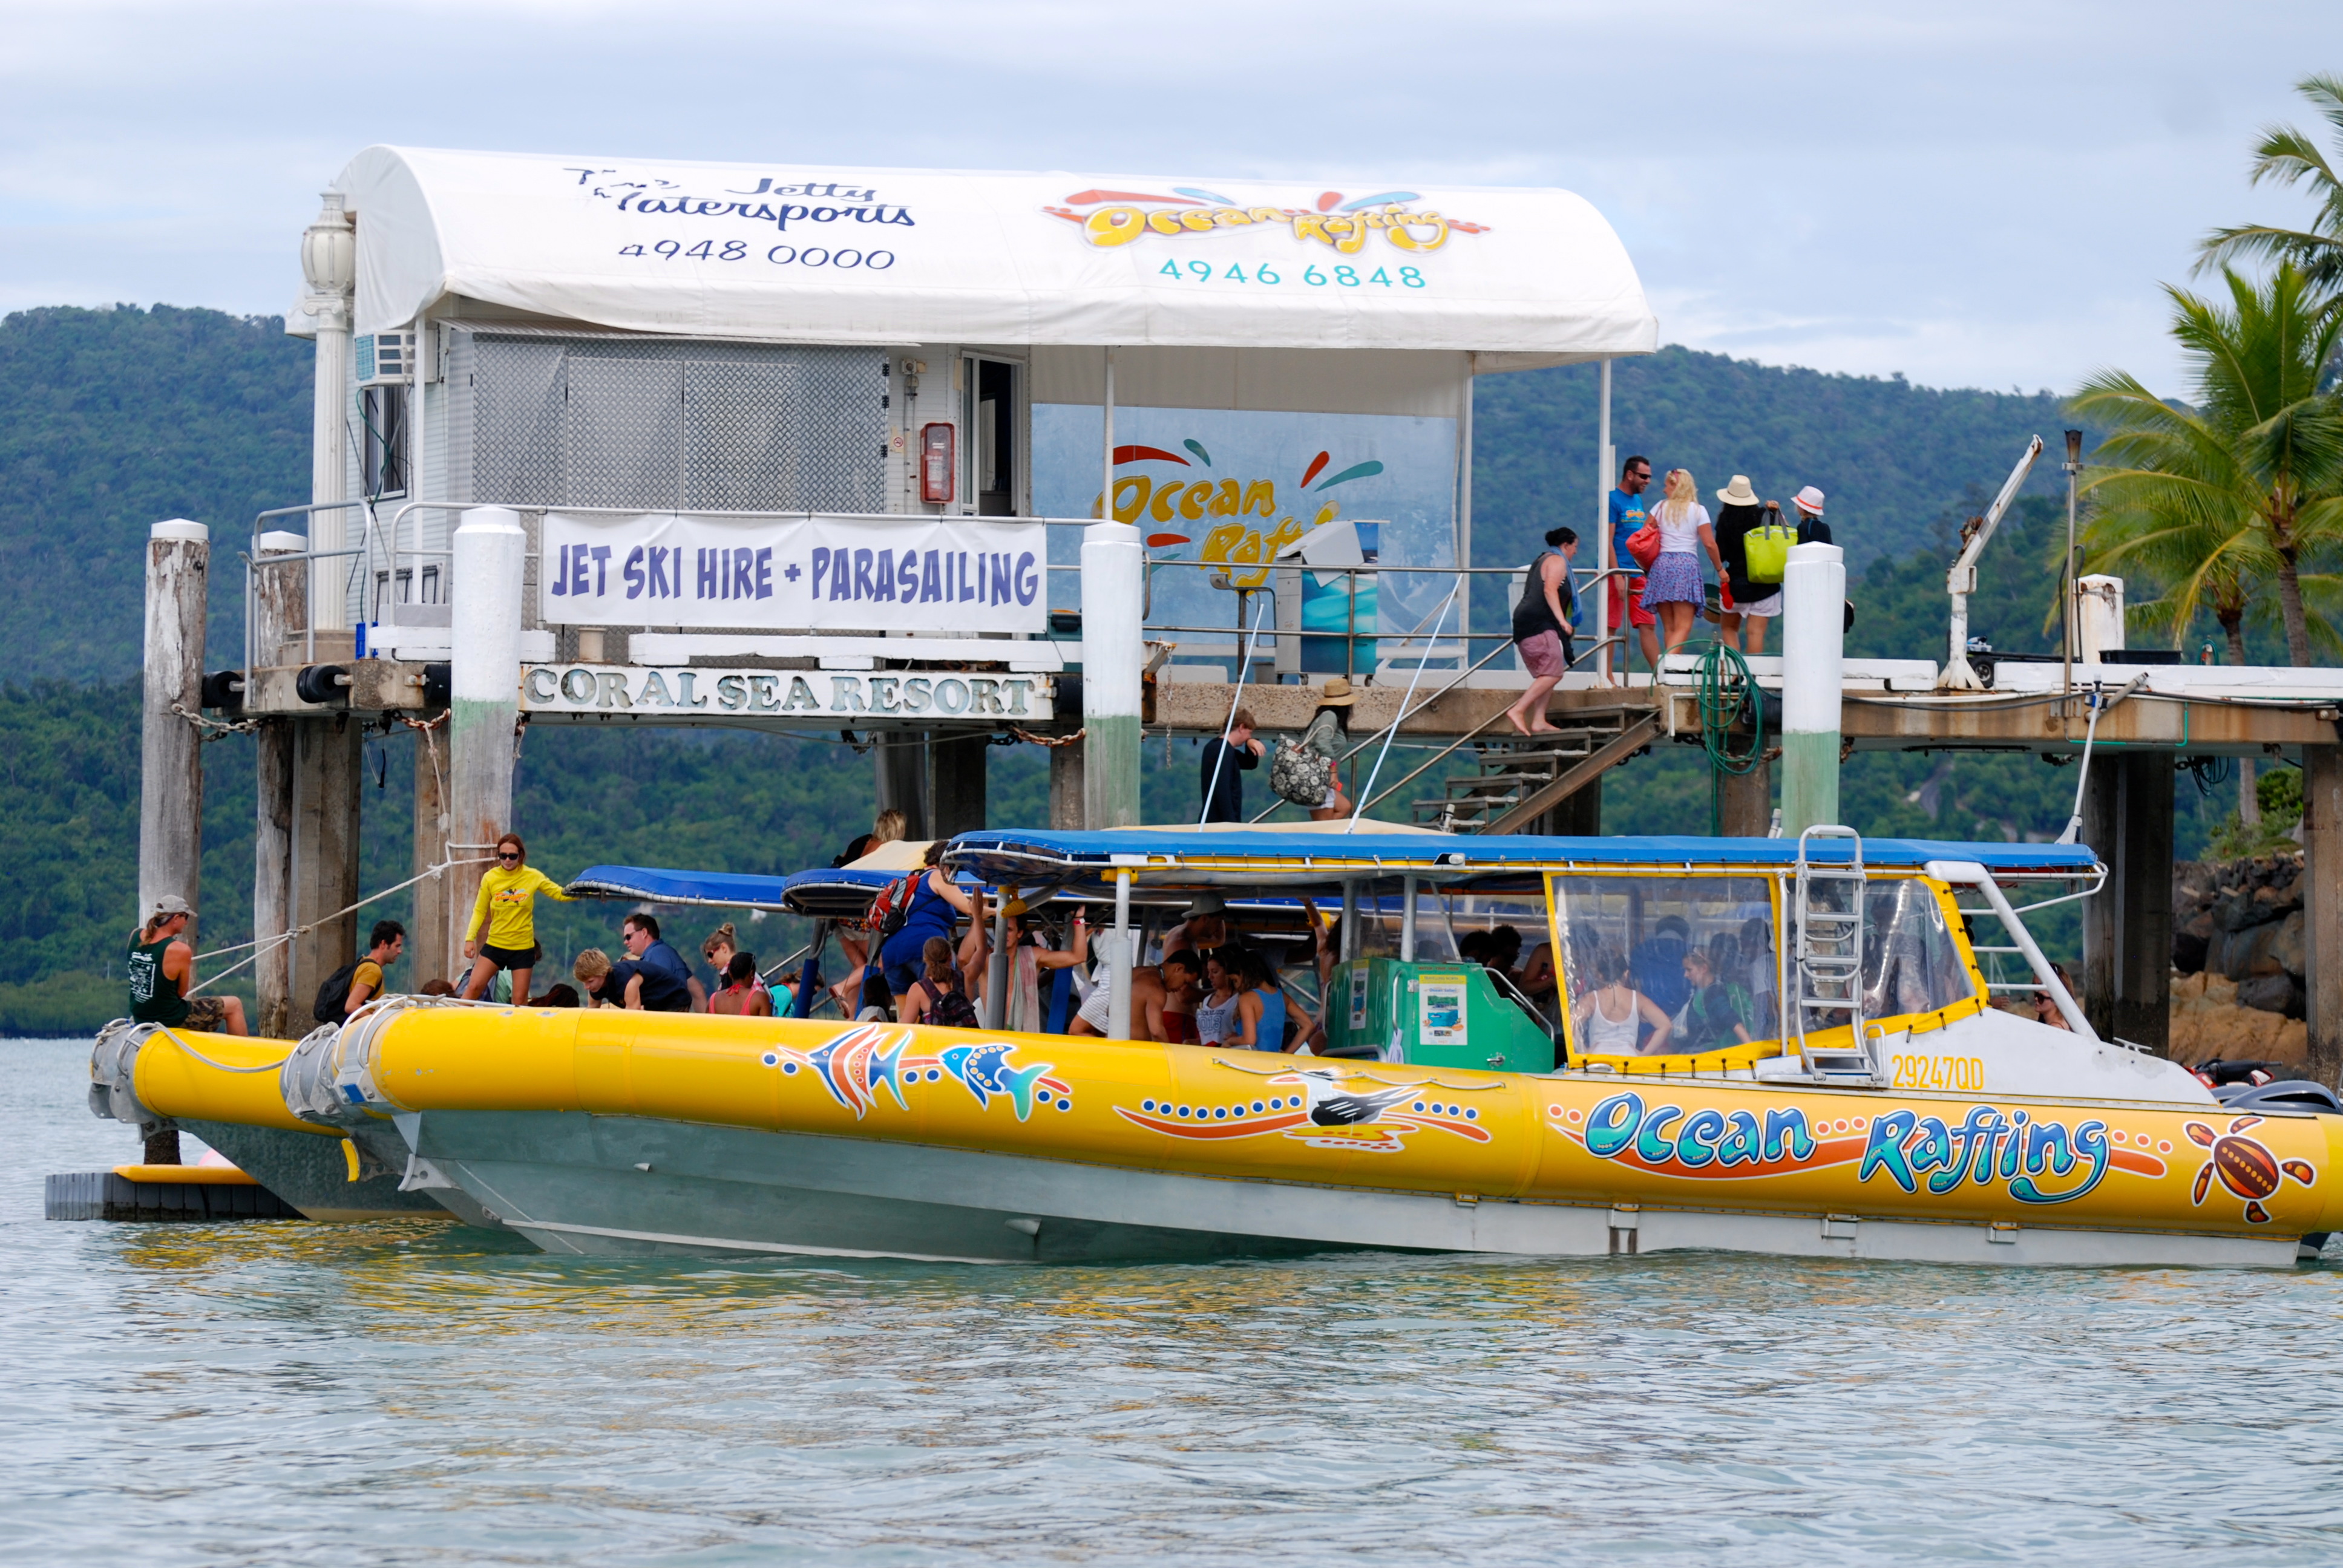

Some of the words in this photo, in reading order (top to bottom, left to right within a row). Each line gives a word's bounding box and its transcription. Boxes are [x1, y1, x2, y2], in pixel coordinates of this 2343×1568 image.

[725, 178, 877, 202] Jetty
[1084, 206, 1292, 247] Ocean
[1293, 204, 1449, 253] Rafting
[767, 245, 895, 270] 0000
[1159, 258, 1282, 285] 4946
[1303, 264, 1427, 289] 6848
[1091, 475, 1277, 524] Ocean
[550, 543, 612, 597] JET
[623, 546, 682, 599] SKI
[697, 547, 773, 600] HIRE
[784, 563, 801, 583] +
[812, 547, 1039, 607] PARASAILING
[523, 668, 708, 708] CORAL
[718, 675, 821, 712] SEA
[830, 676, 1035, 715] RESORT
[1892, 1054, 1985, 1090] 29247QD
[1585, 1091, 1817, 1168] Ocean
[1859, 1105, 2111, 1204] Rafting
